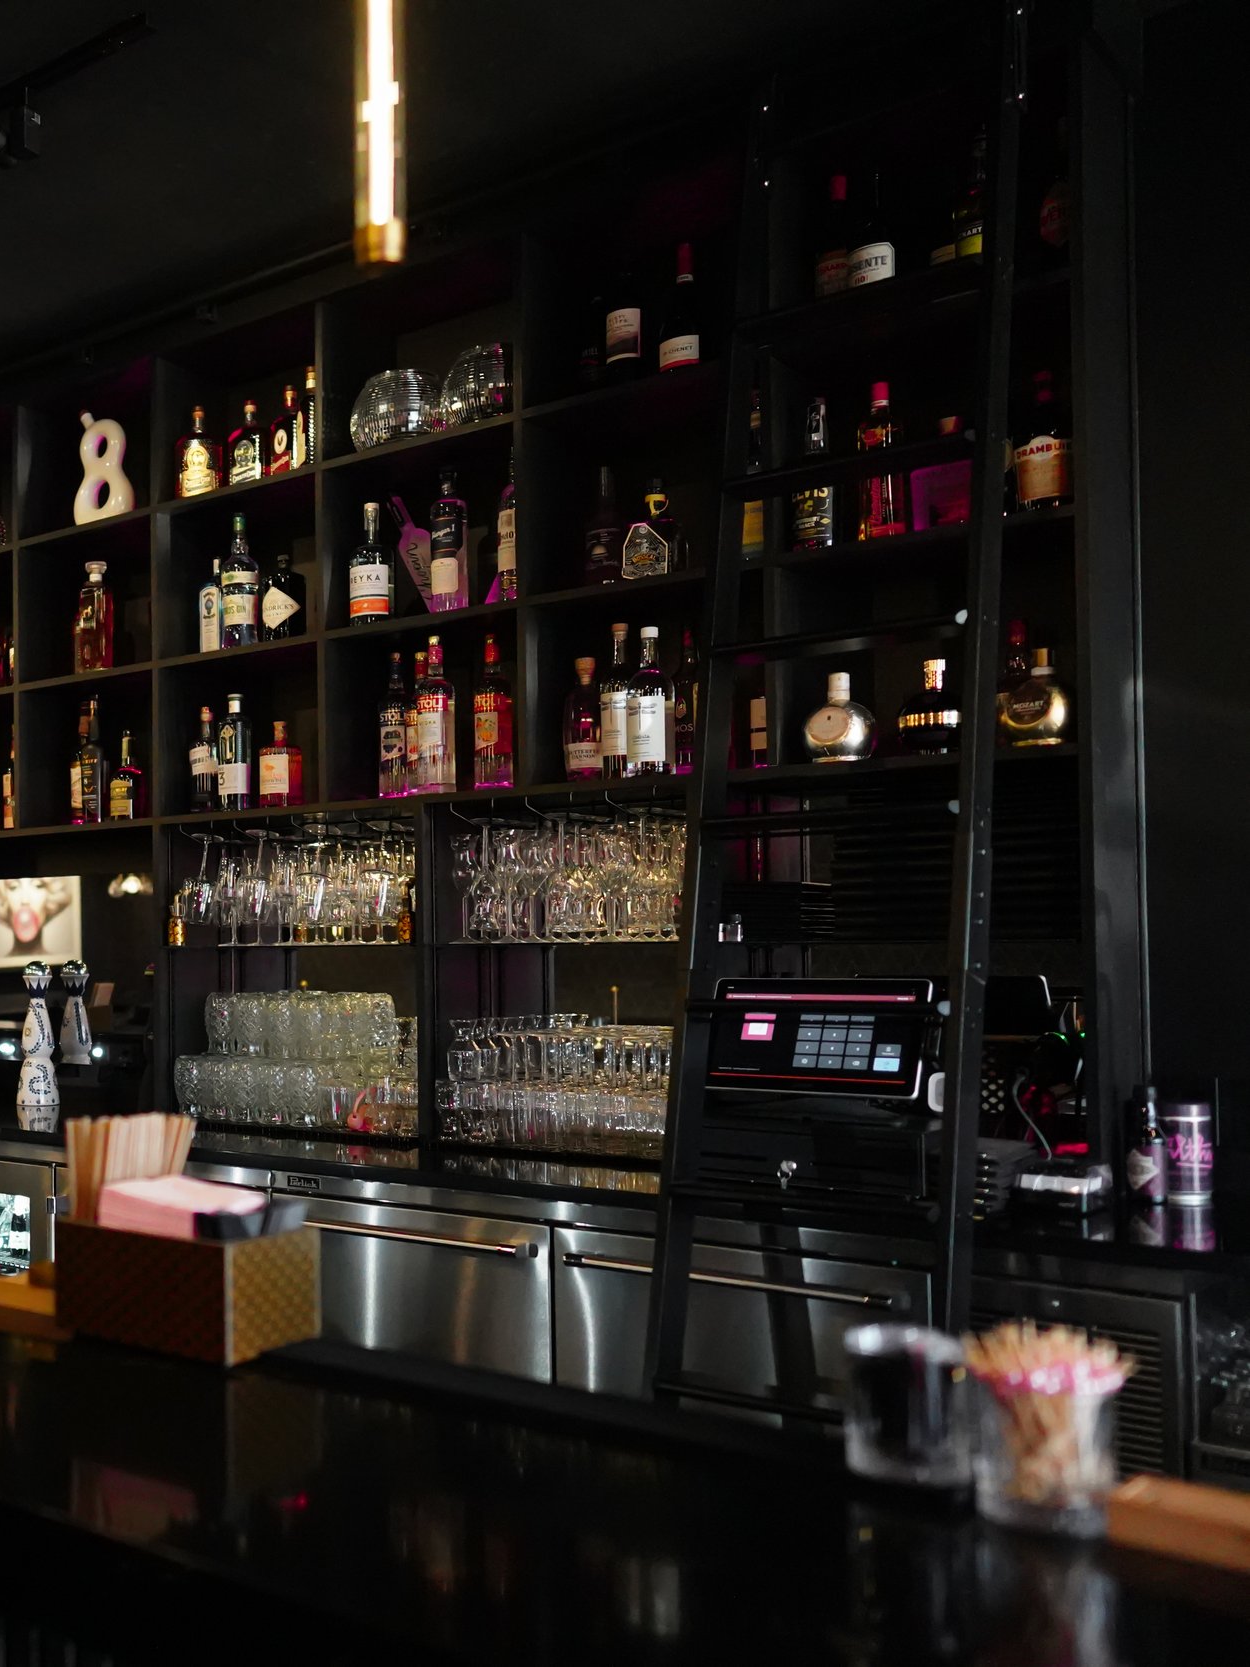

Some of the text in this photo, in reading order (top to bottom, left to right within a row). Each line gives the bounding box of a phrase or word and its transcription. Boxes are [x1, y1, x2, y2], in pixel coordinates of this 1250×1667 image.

[851, 255, 888, 273] SENTE
[1016, 441, 1067, 460] DRAMBUI
[416, 699, 443, 709] STOLI
[1012, 700, 1044, 709] MOZART
[379, 712, 402, 723] STOL
[218, 771, 226, 786] 3
